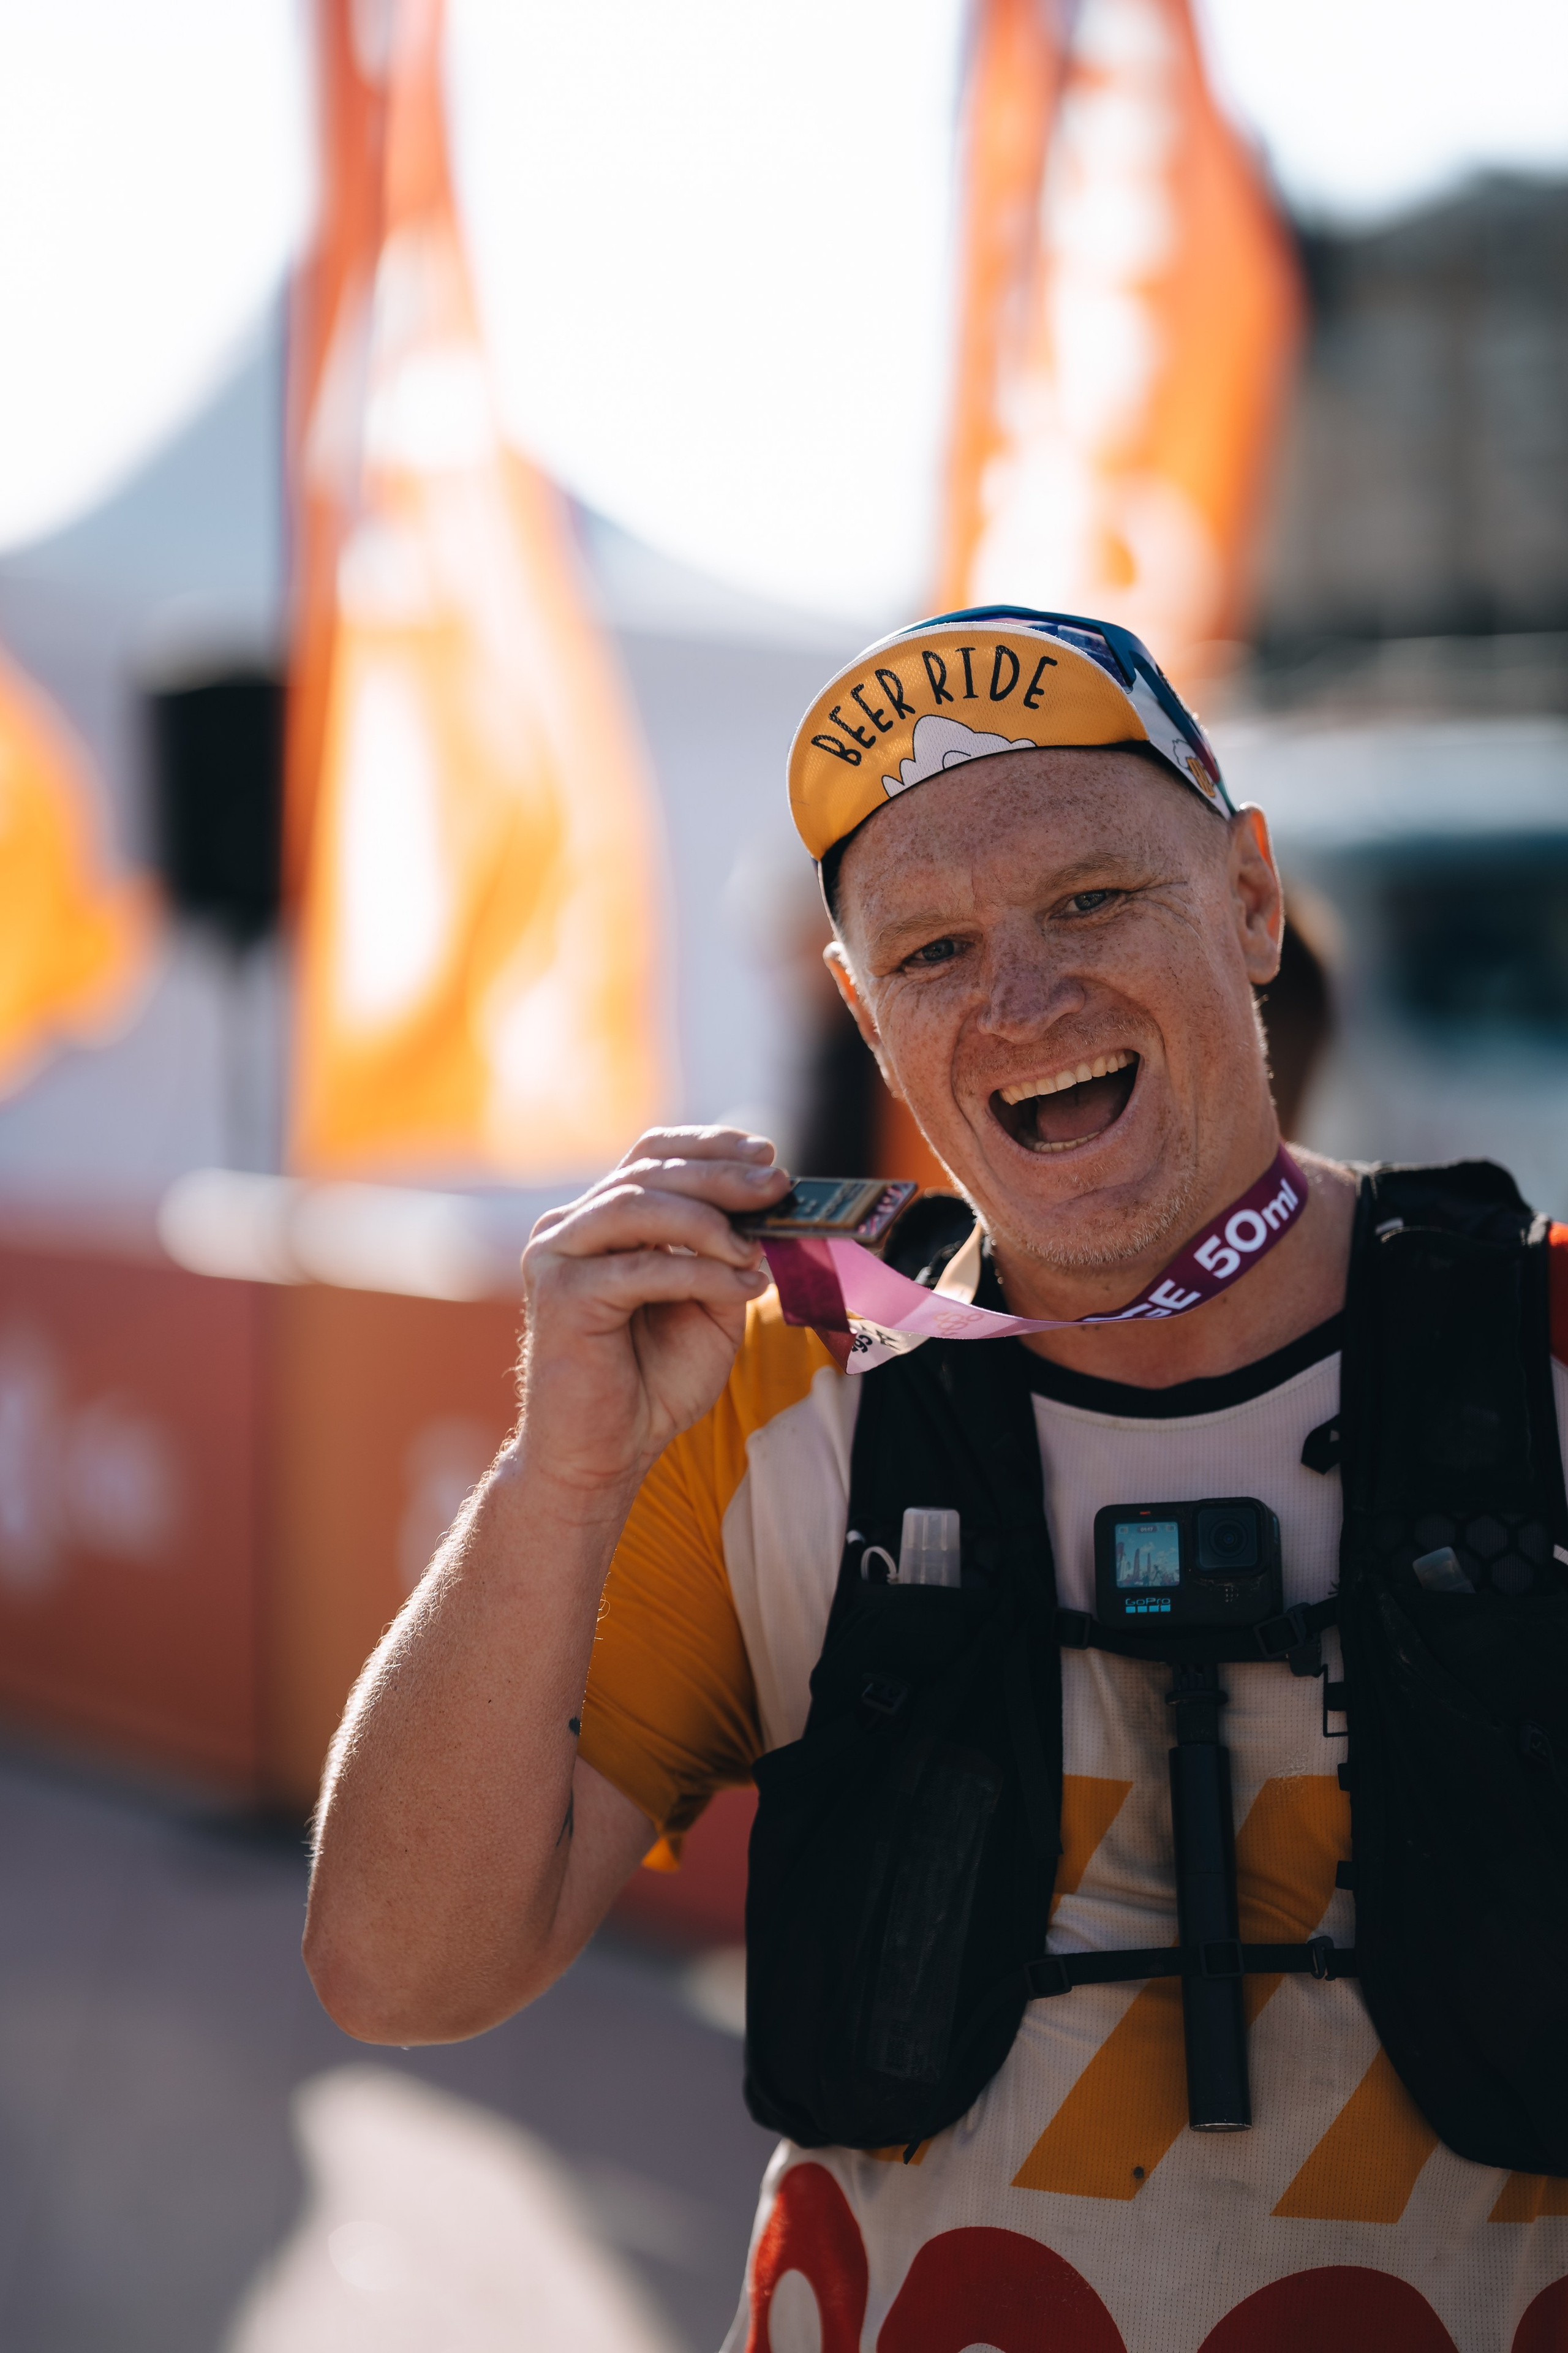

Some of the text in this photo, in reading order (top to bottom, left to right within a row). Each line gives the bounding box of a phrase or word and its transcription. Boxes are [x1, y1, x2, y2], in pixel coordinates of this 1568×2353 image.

[811, 644, 1058, 766] BEER RIDE
[1125, 1597, 1171, 1606] GoPro
